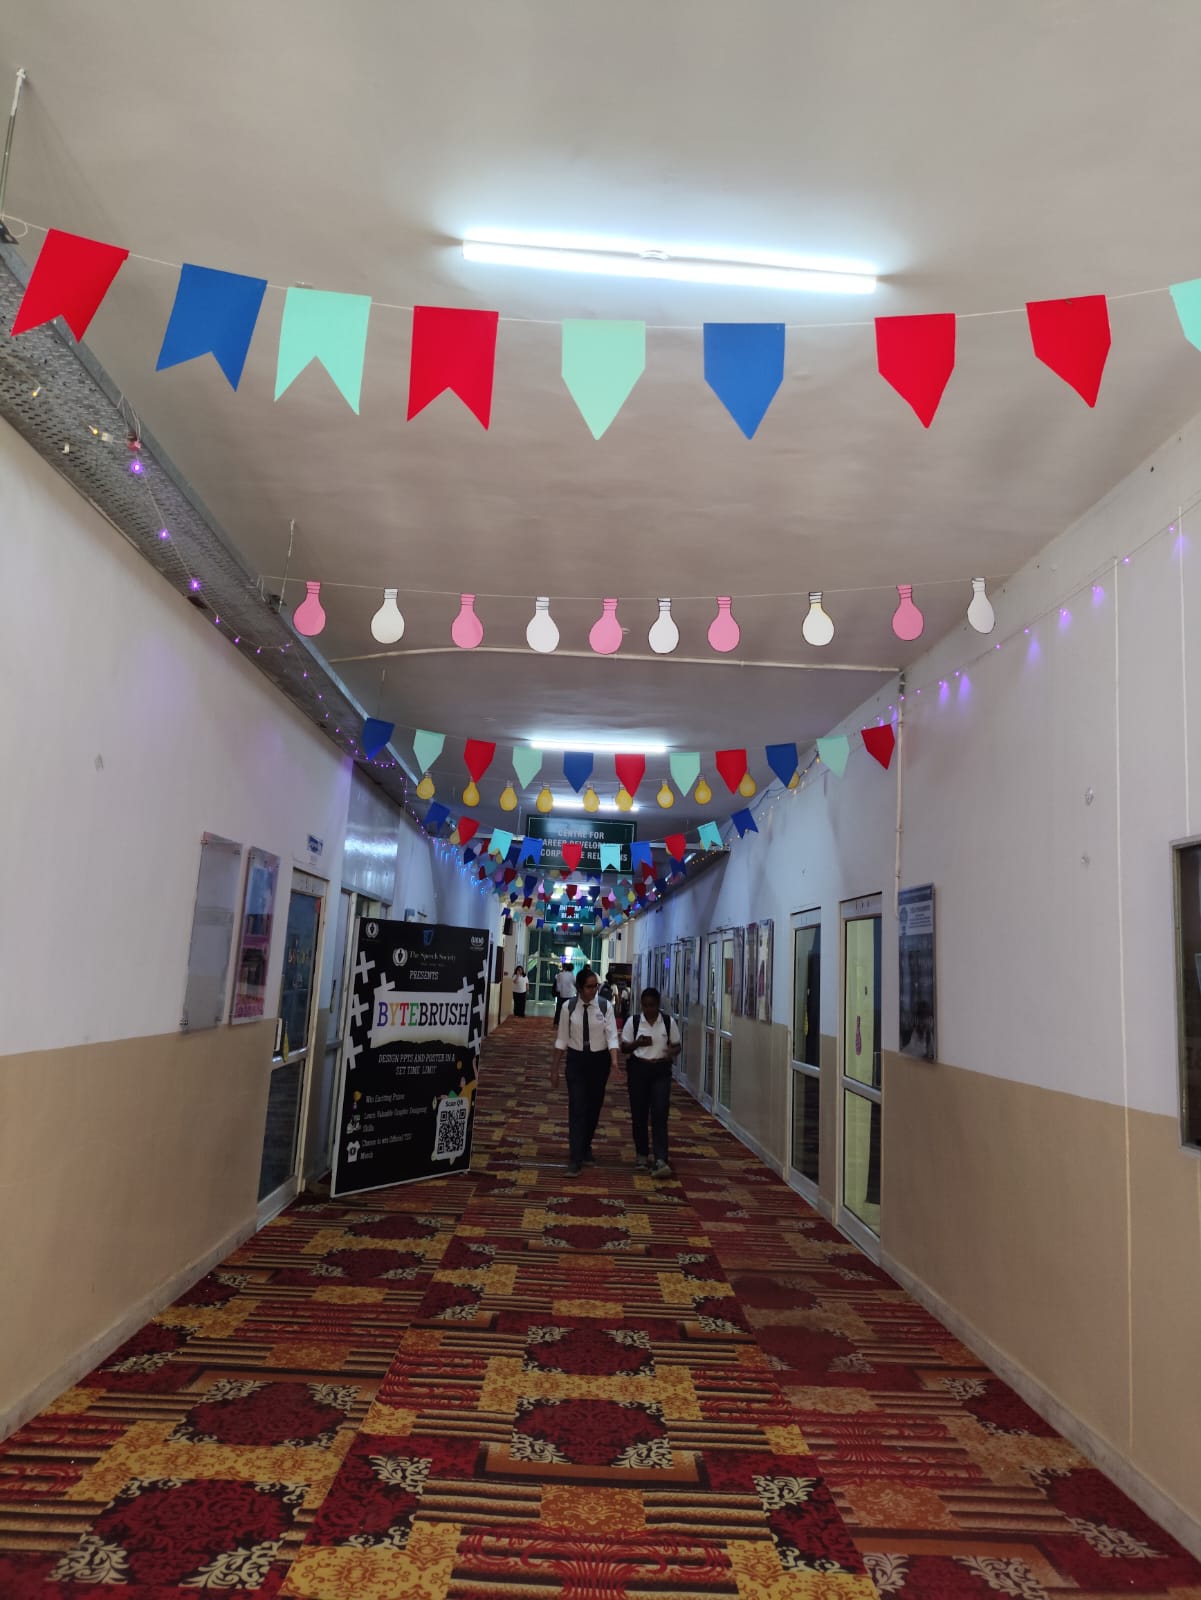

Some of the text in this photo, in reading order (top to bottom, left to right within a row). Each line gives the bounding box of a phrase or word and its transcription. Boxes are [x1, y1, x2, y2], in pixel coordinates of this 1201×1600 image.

[558, 830, 605, 840] CENTRE FOR
[409, 970, 439, 981] PRESENTS
[376, 1001, 469, 1027] BYTEBRUSH
[414, 1053, 425, 1063] AND
